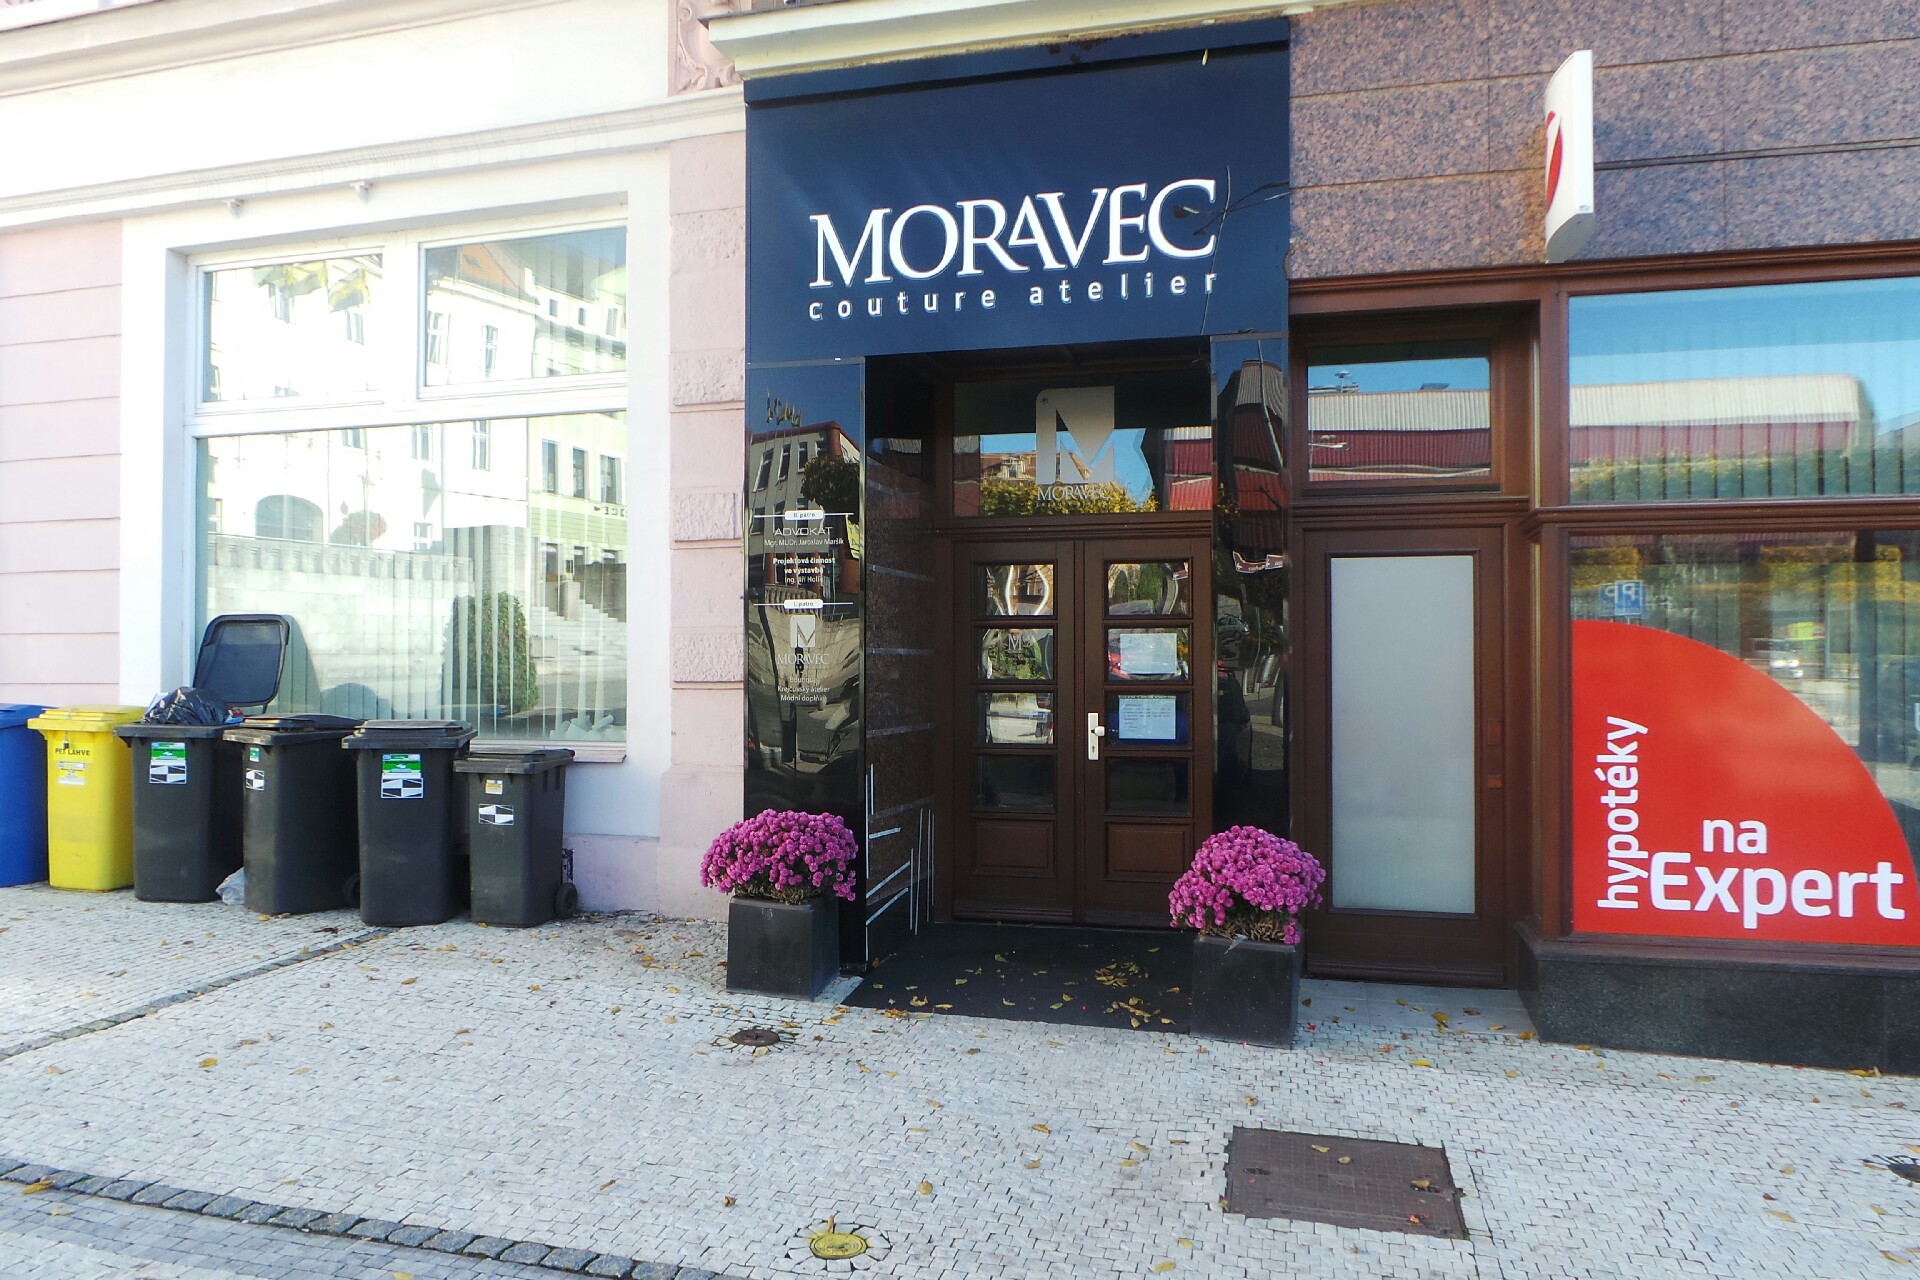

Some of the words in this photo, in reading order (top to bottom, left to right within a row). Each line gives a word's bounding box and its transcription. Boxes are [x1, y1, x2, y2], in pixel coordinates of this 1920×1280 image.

[808, 178, 1217, 288] MORAVEC
[808, 289, 997, 320] couture
[1028, 271, 1218, 306] atelier
[774, 526, 834, 536] ADVOKAT
[798, 538, 823, 546] Jaroslav
[772, 556, 810, 566] Projektová
[777, 653, 830, 665] MORAVEC
[67, 749, 91, 757] LAHVE
[1594, 715, 1649, 910] hypotéky
[1702, 818, 1768, 855] na
[1649, 851, 1906, 930] Expert
